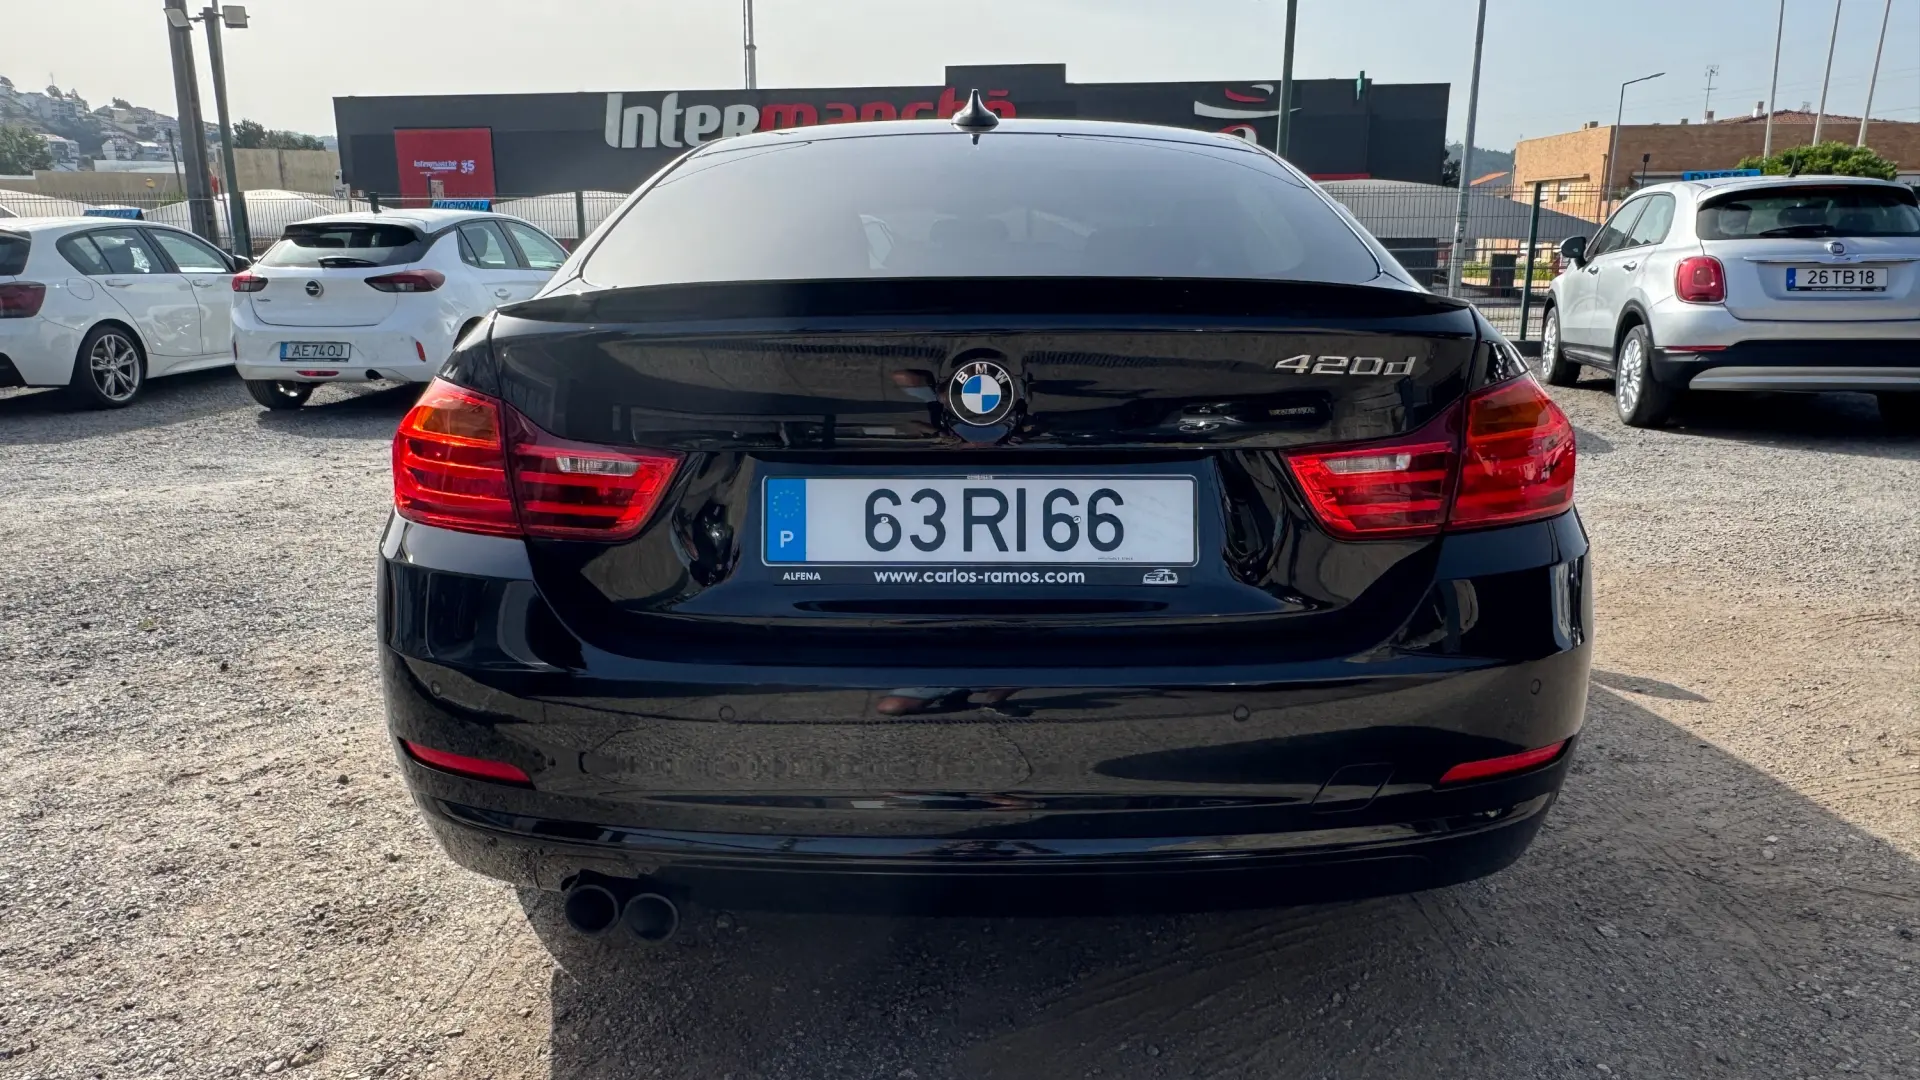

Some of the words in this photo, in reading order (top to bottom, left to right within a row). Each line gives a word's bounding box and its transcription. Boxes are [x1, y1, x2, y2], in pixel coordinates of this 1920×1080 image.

[1275, 354, 1416, 375] 420d
[956, 363, 1008, 385] BMW
[780, 531, 794, 548] P
[783, 572, 821, 580] ALFENA
[874, 569, 1085, 583] www.carlos-ramos.com
